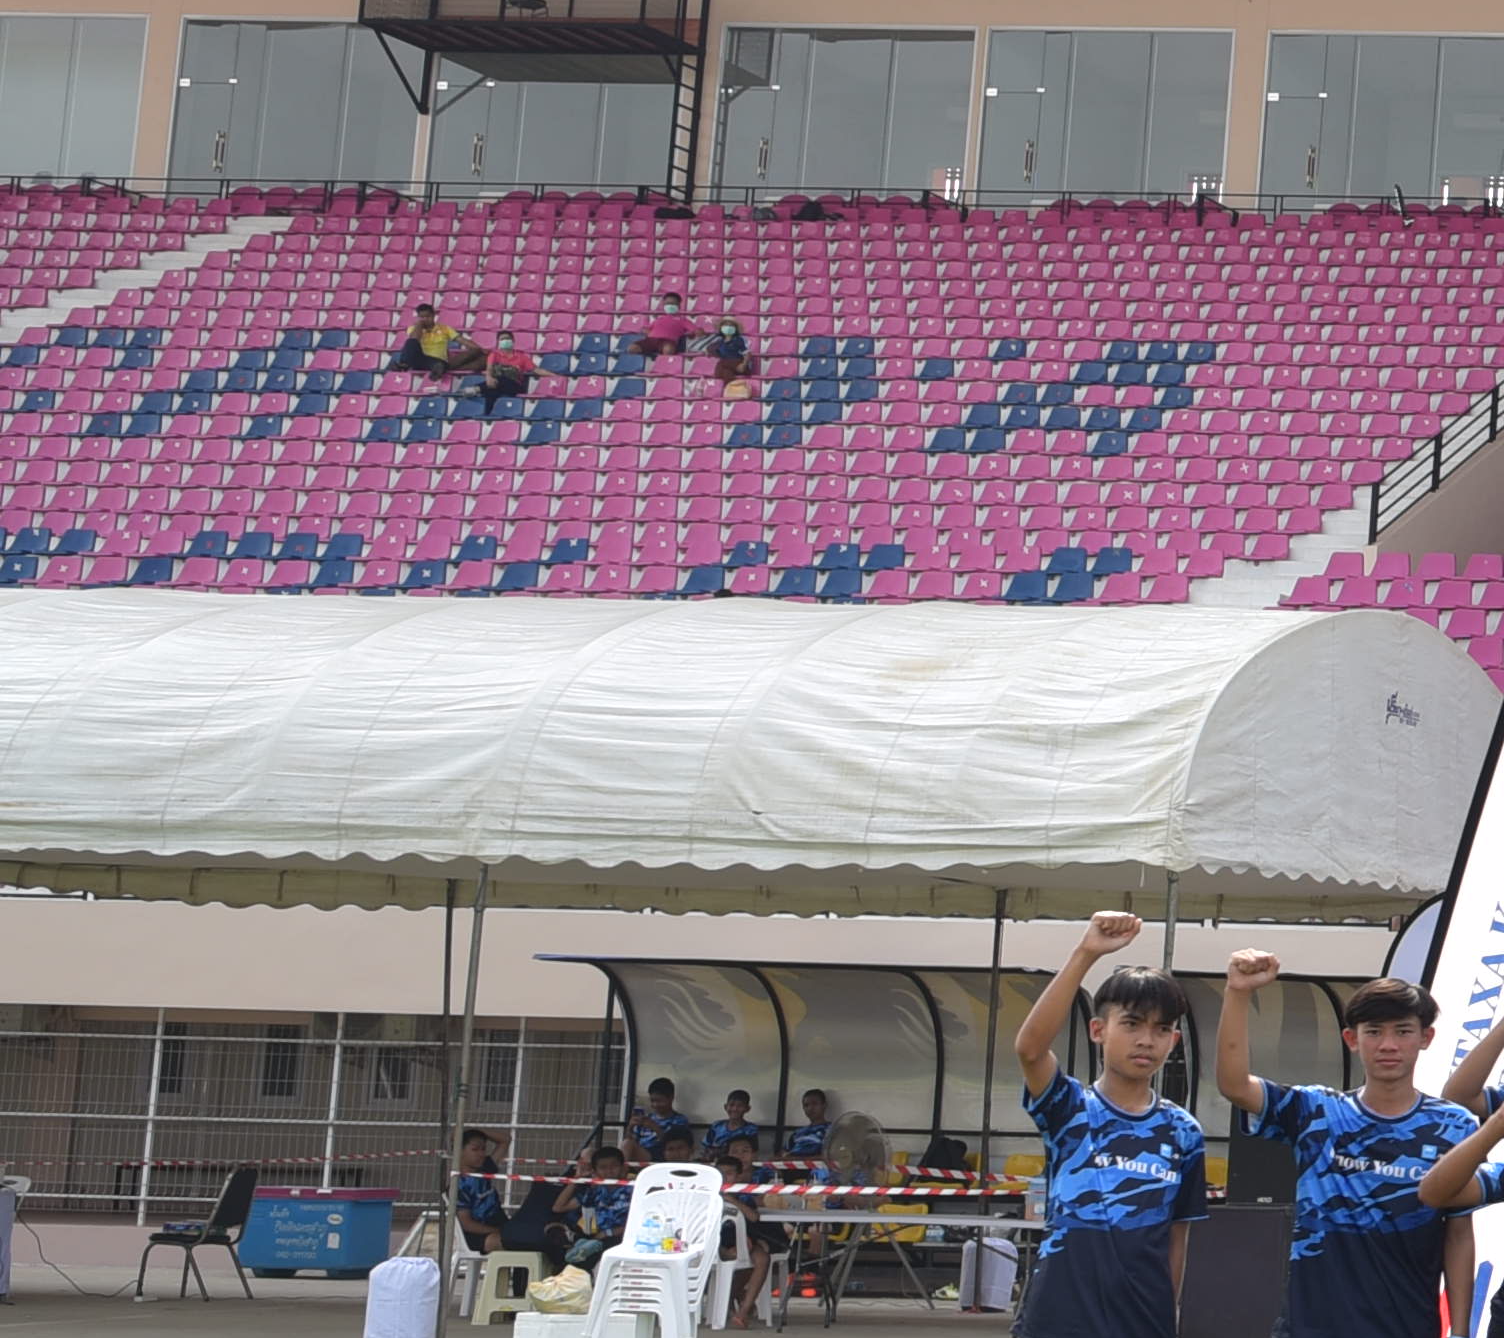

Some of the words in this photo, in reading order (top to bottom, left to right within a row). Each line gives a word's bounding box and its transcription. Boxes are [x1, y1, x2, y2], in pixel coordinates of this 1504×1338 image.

[1116, 1154, 1148, 1173] You
[1150, 1162, 1177, 1181] Can
[1373, 1155, 1408, 1178] You
[1409, 1165, 1431, 1180] Ca
